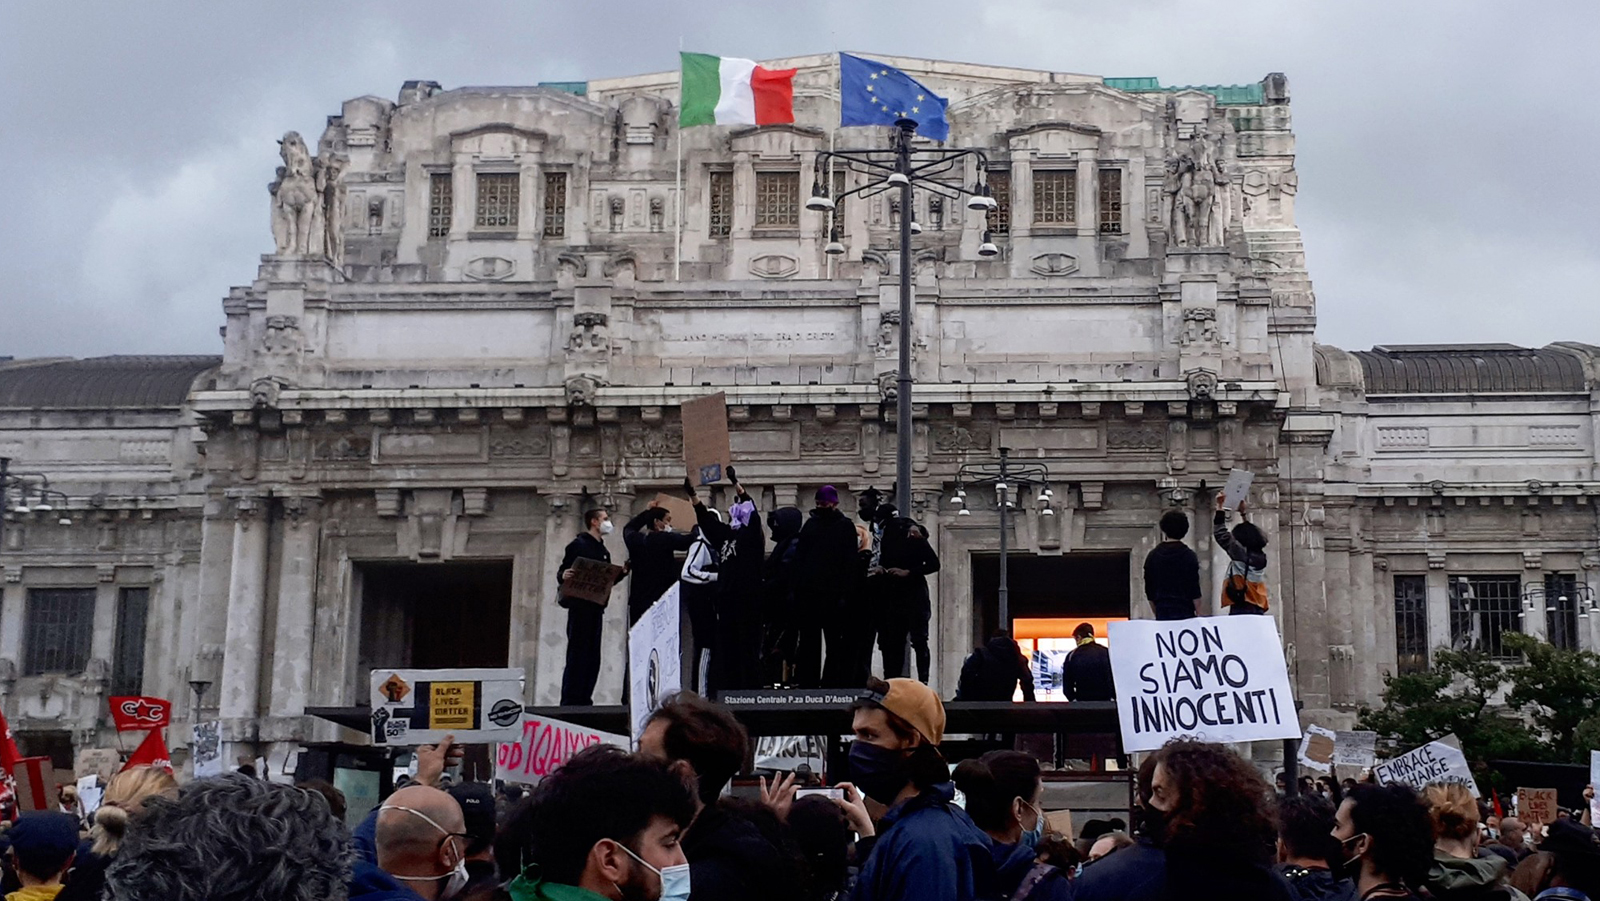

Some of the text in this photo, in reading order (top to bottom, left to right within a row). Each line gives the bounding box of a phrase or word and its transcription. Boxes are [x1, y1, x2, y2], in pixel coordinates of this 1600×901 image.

[1156, 626, 1224, 658] NON
[1140, 655, 1249, 694] SIAMO
[724, 695, 755, 704] Stazione
[757, 695, 787, 704] Centrale
[788, 695, 803, 704] P.za
[805, 695, 823, 703] Duca
[825, 695, 853, 703] D'Aosta
[1131, 688, 1281, 734] INNOCENTI
[1377, 744, 1437, 786] EMBRACE
[1519, 789, 1553, 801] BLACK
